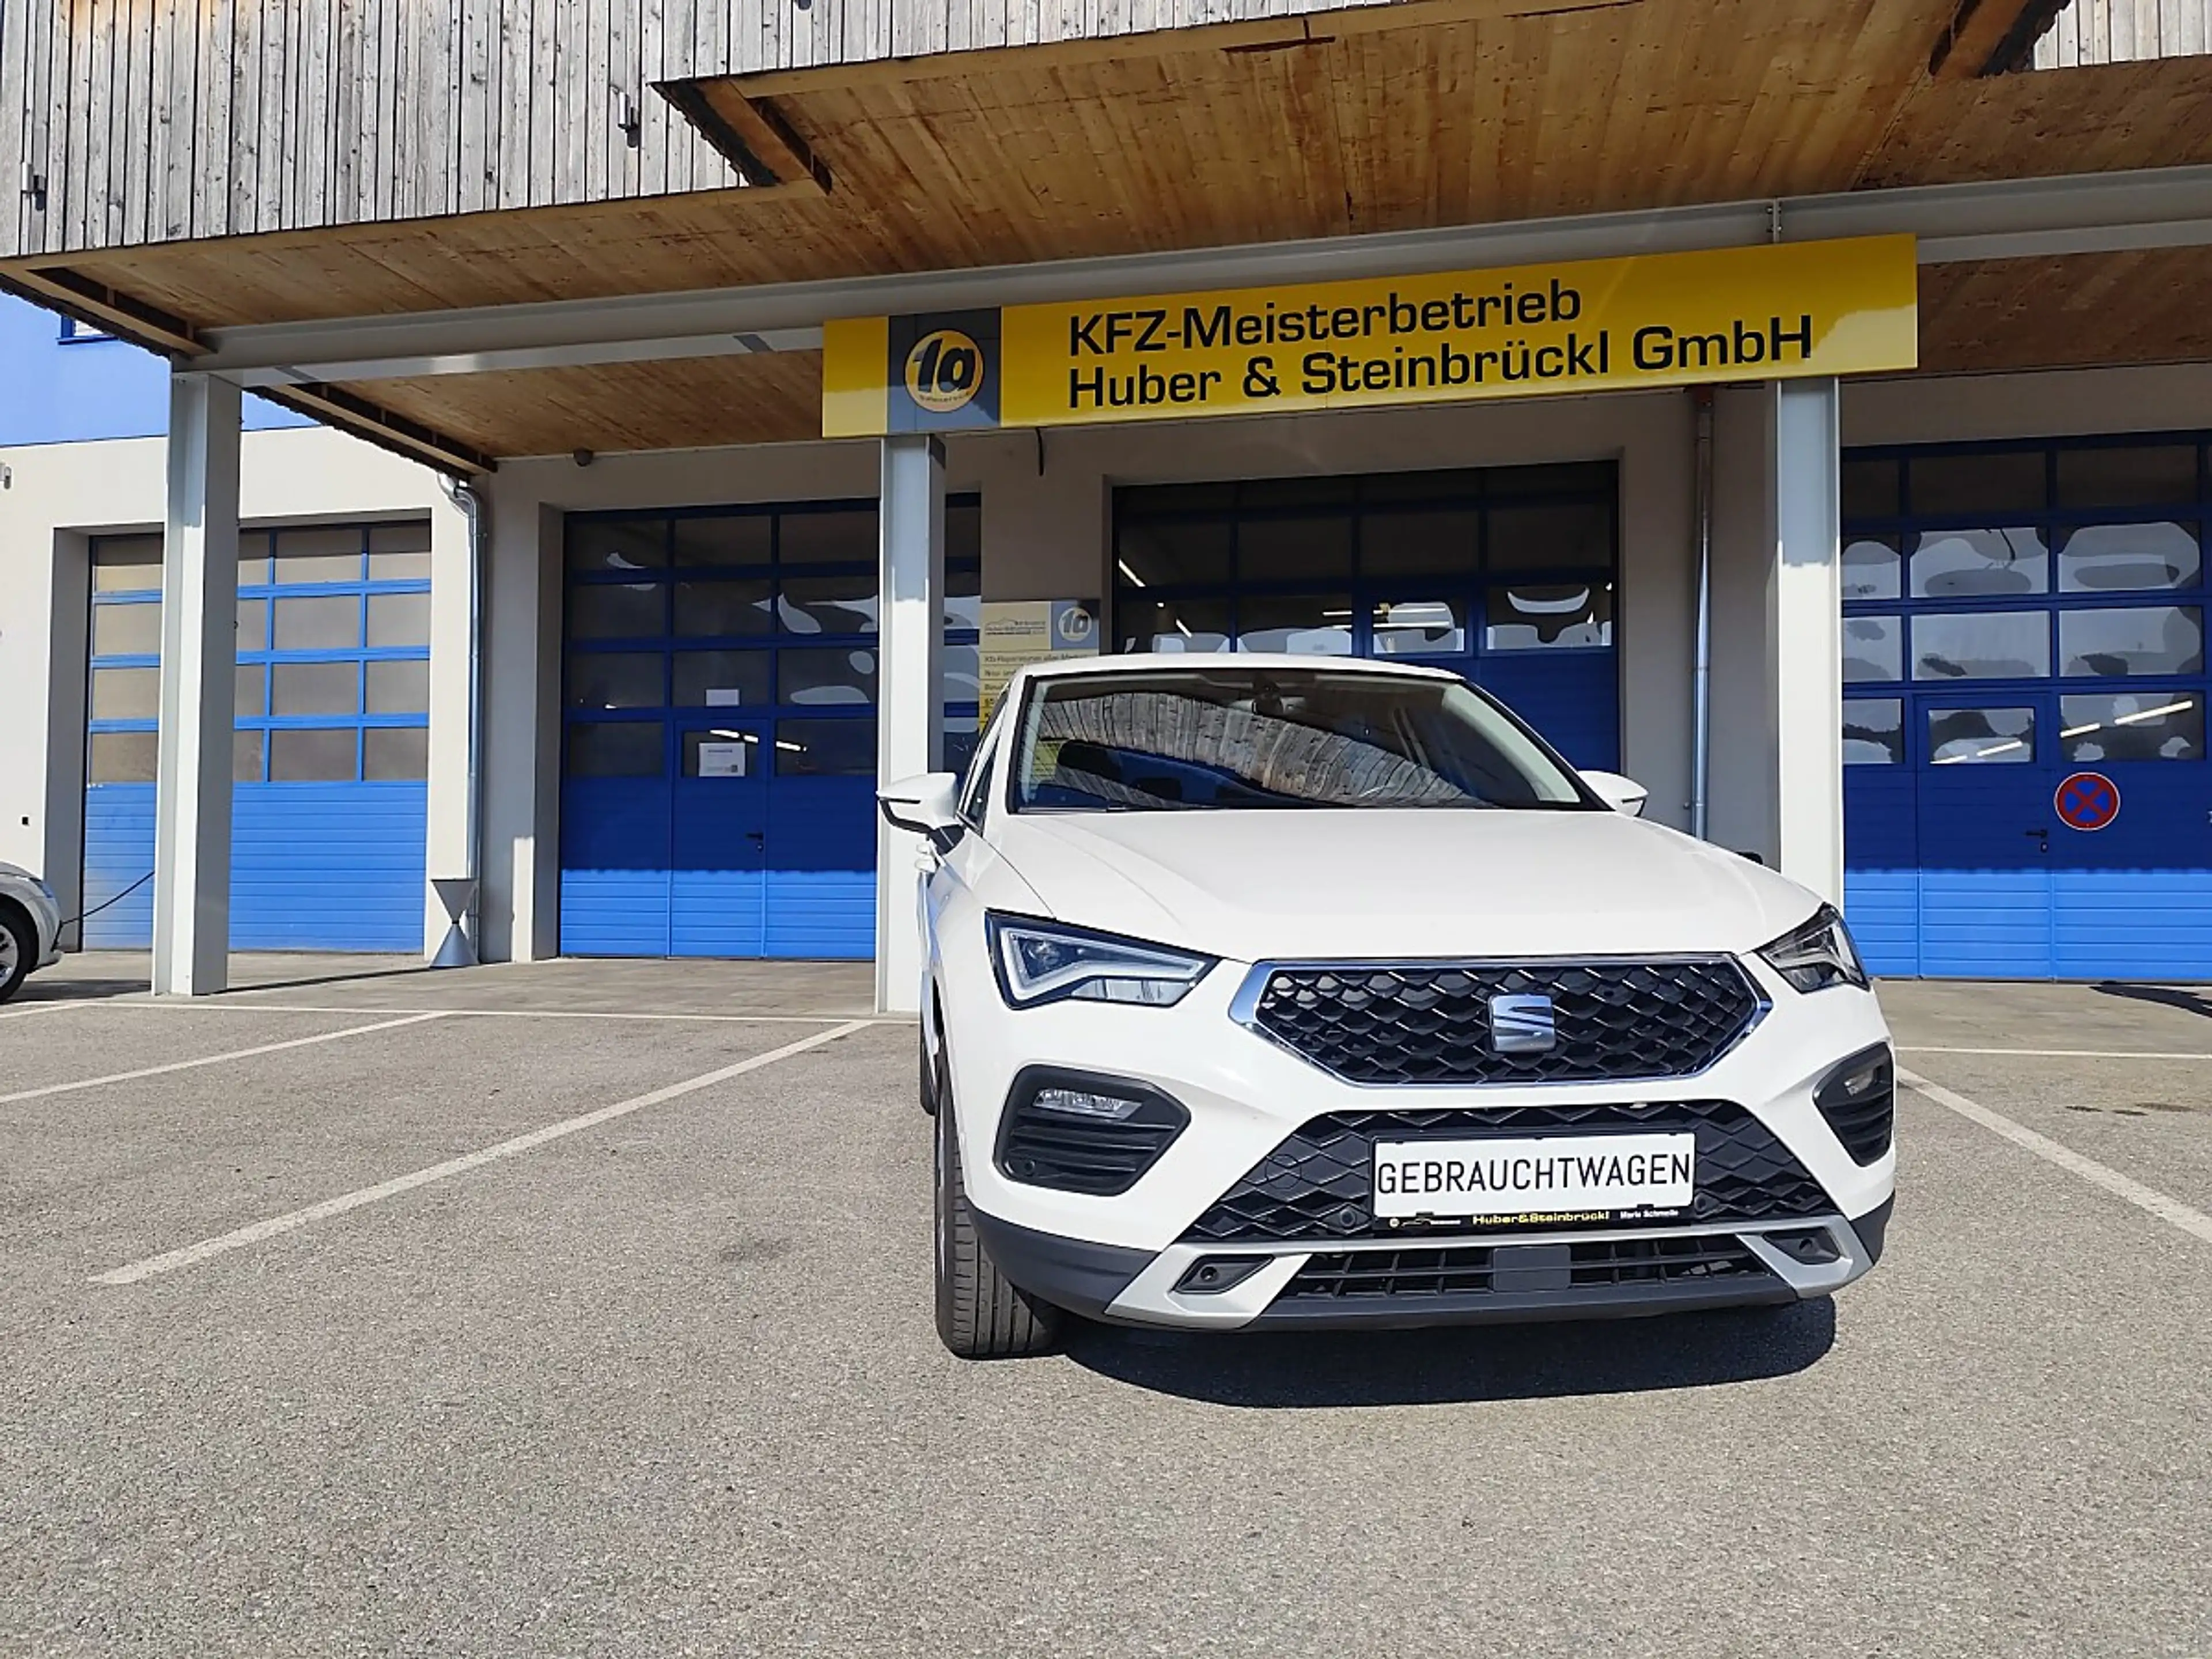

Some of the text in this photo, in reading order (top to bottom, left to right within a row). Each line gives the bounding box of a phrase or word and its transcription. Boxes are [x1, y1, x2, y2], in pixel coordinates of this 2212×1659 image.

[1070, 278, 1581, 357] KFZ-Meisterbetrieb
[1070, 315, 1811, 408] Huber & Steinbrückl GmbH
[1377, 1153, 1690, 1194] GEBRAUCHTWAGEN
